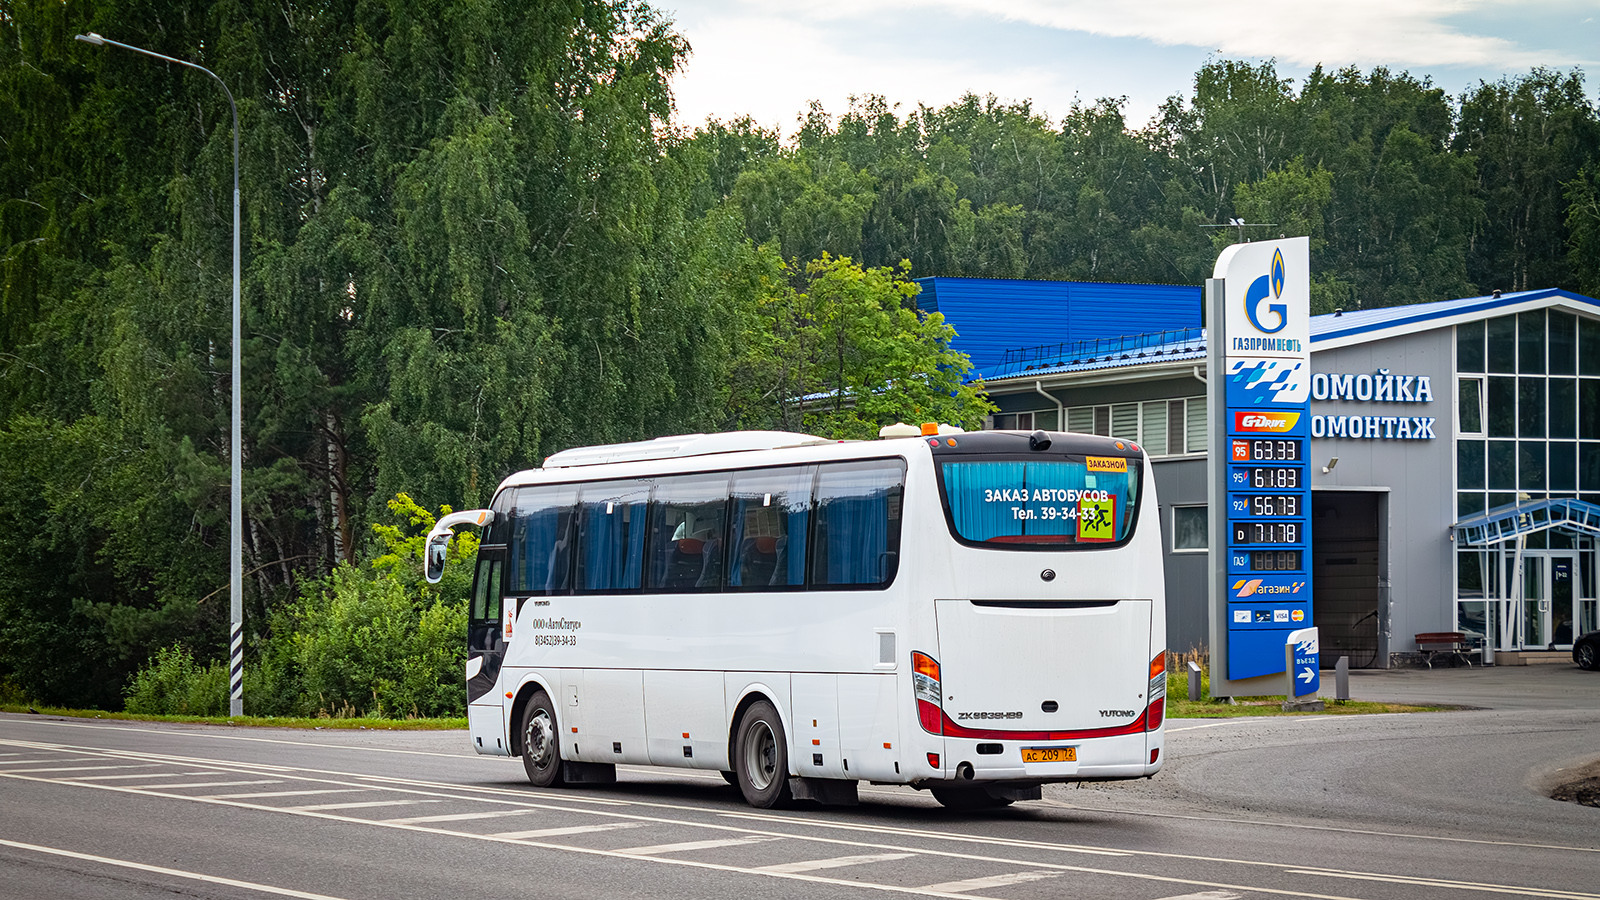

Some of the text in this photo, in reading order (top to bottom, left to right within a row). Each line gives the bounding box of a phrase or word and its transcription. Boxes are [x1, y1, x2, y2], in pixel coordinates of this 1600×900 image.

[1233, 337, 1301, 352] ГАЗПРОМНЕФТЬ
[1235, 441, 1296, 460] 95 63.33
[1088, 459, 1126, 469] ЗАКАЗНОЙ
[1233, 469, 1296, 488] 95 61.83
[984, 489, 1109, 504] ЗАКАЗ АВТОБУСОВ
[1233, 496, 1296, 516] 92 56.73
[1011, 507, 1096, 520] Тел. 39-34-33
[1237, 524, 1296, 543] D 71.78
[1233, 556, 1245, 566] ГАЗ
[535, 635, 576, 646] 8(3452)39-34-33
[1296, 657, 1316, 665] ВЪЕЗД
[1099, 709, 1136, 718] YUTONG
[1026, 748, 1073, 761] АС 209 72
